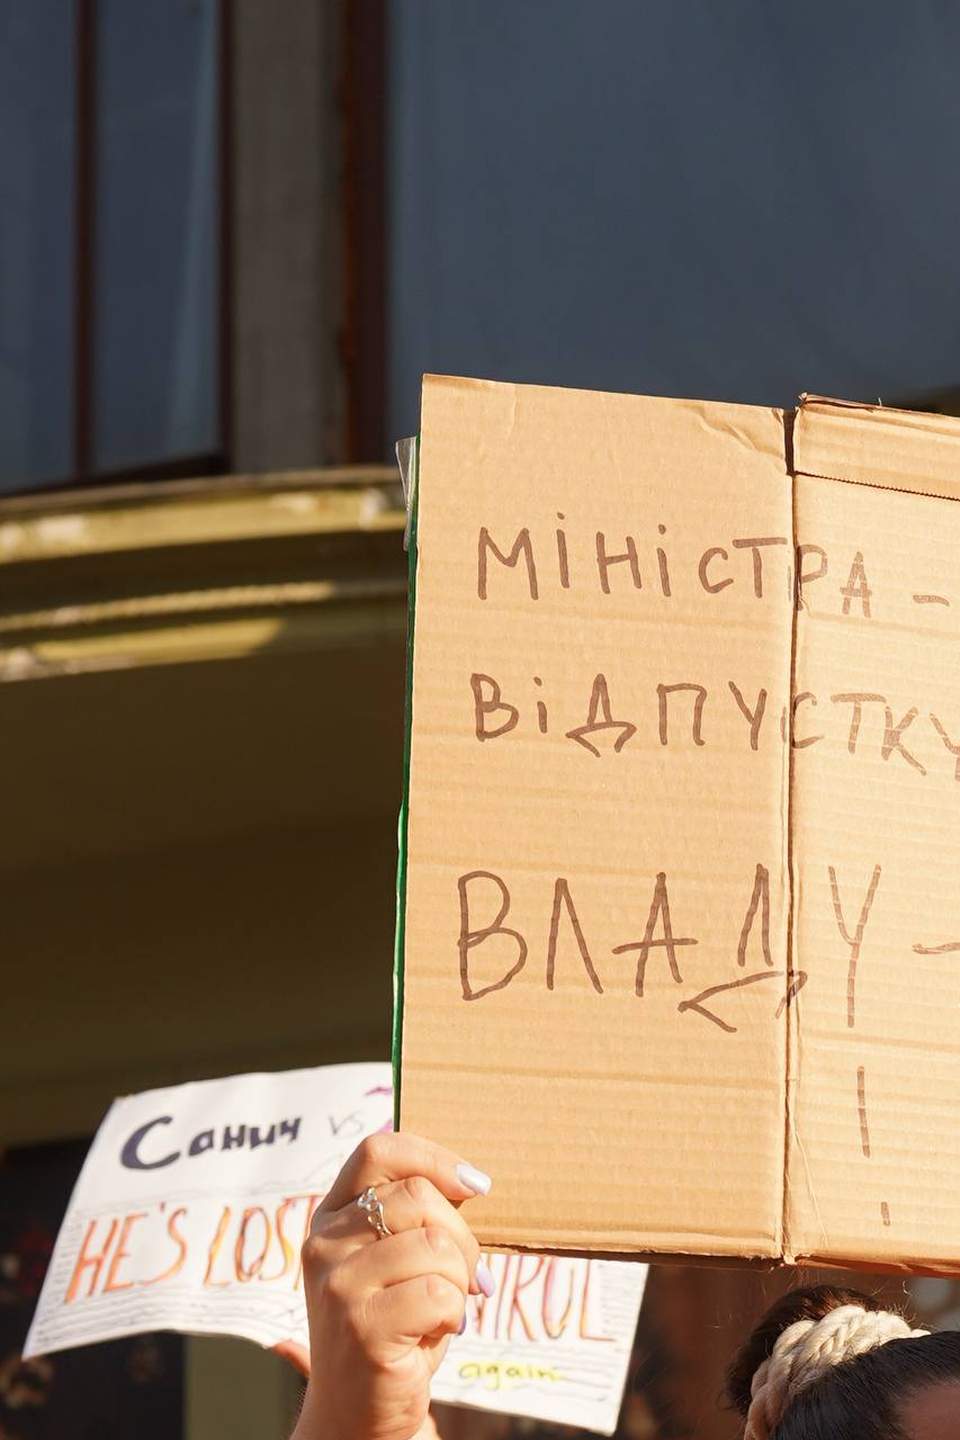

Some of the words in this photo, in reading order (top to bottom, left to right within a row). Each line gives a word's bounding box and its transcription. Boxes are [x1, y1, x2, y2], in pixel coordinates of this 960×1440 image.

[456, 863, 882, 1033] ВЛАДУ
[120, 1115, 303, 1170] Санич
[64, 1199, 188, 1305] HE'S
